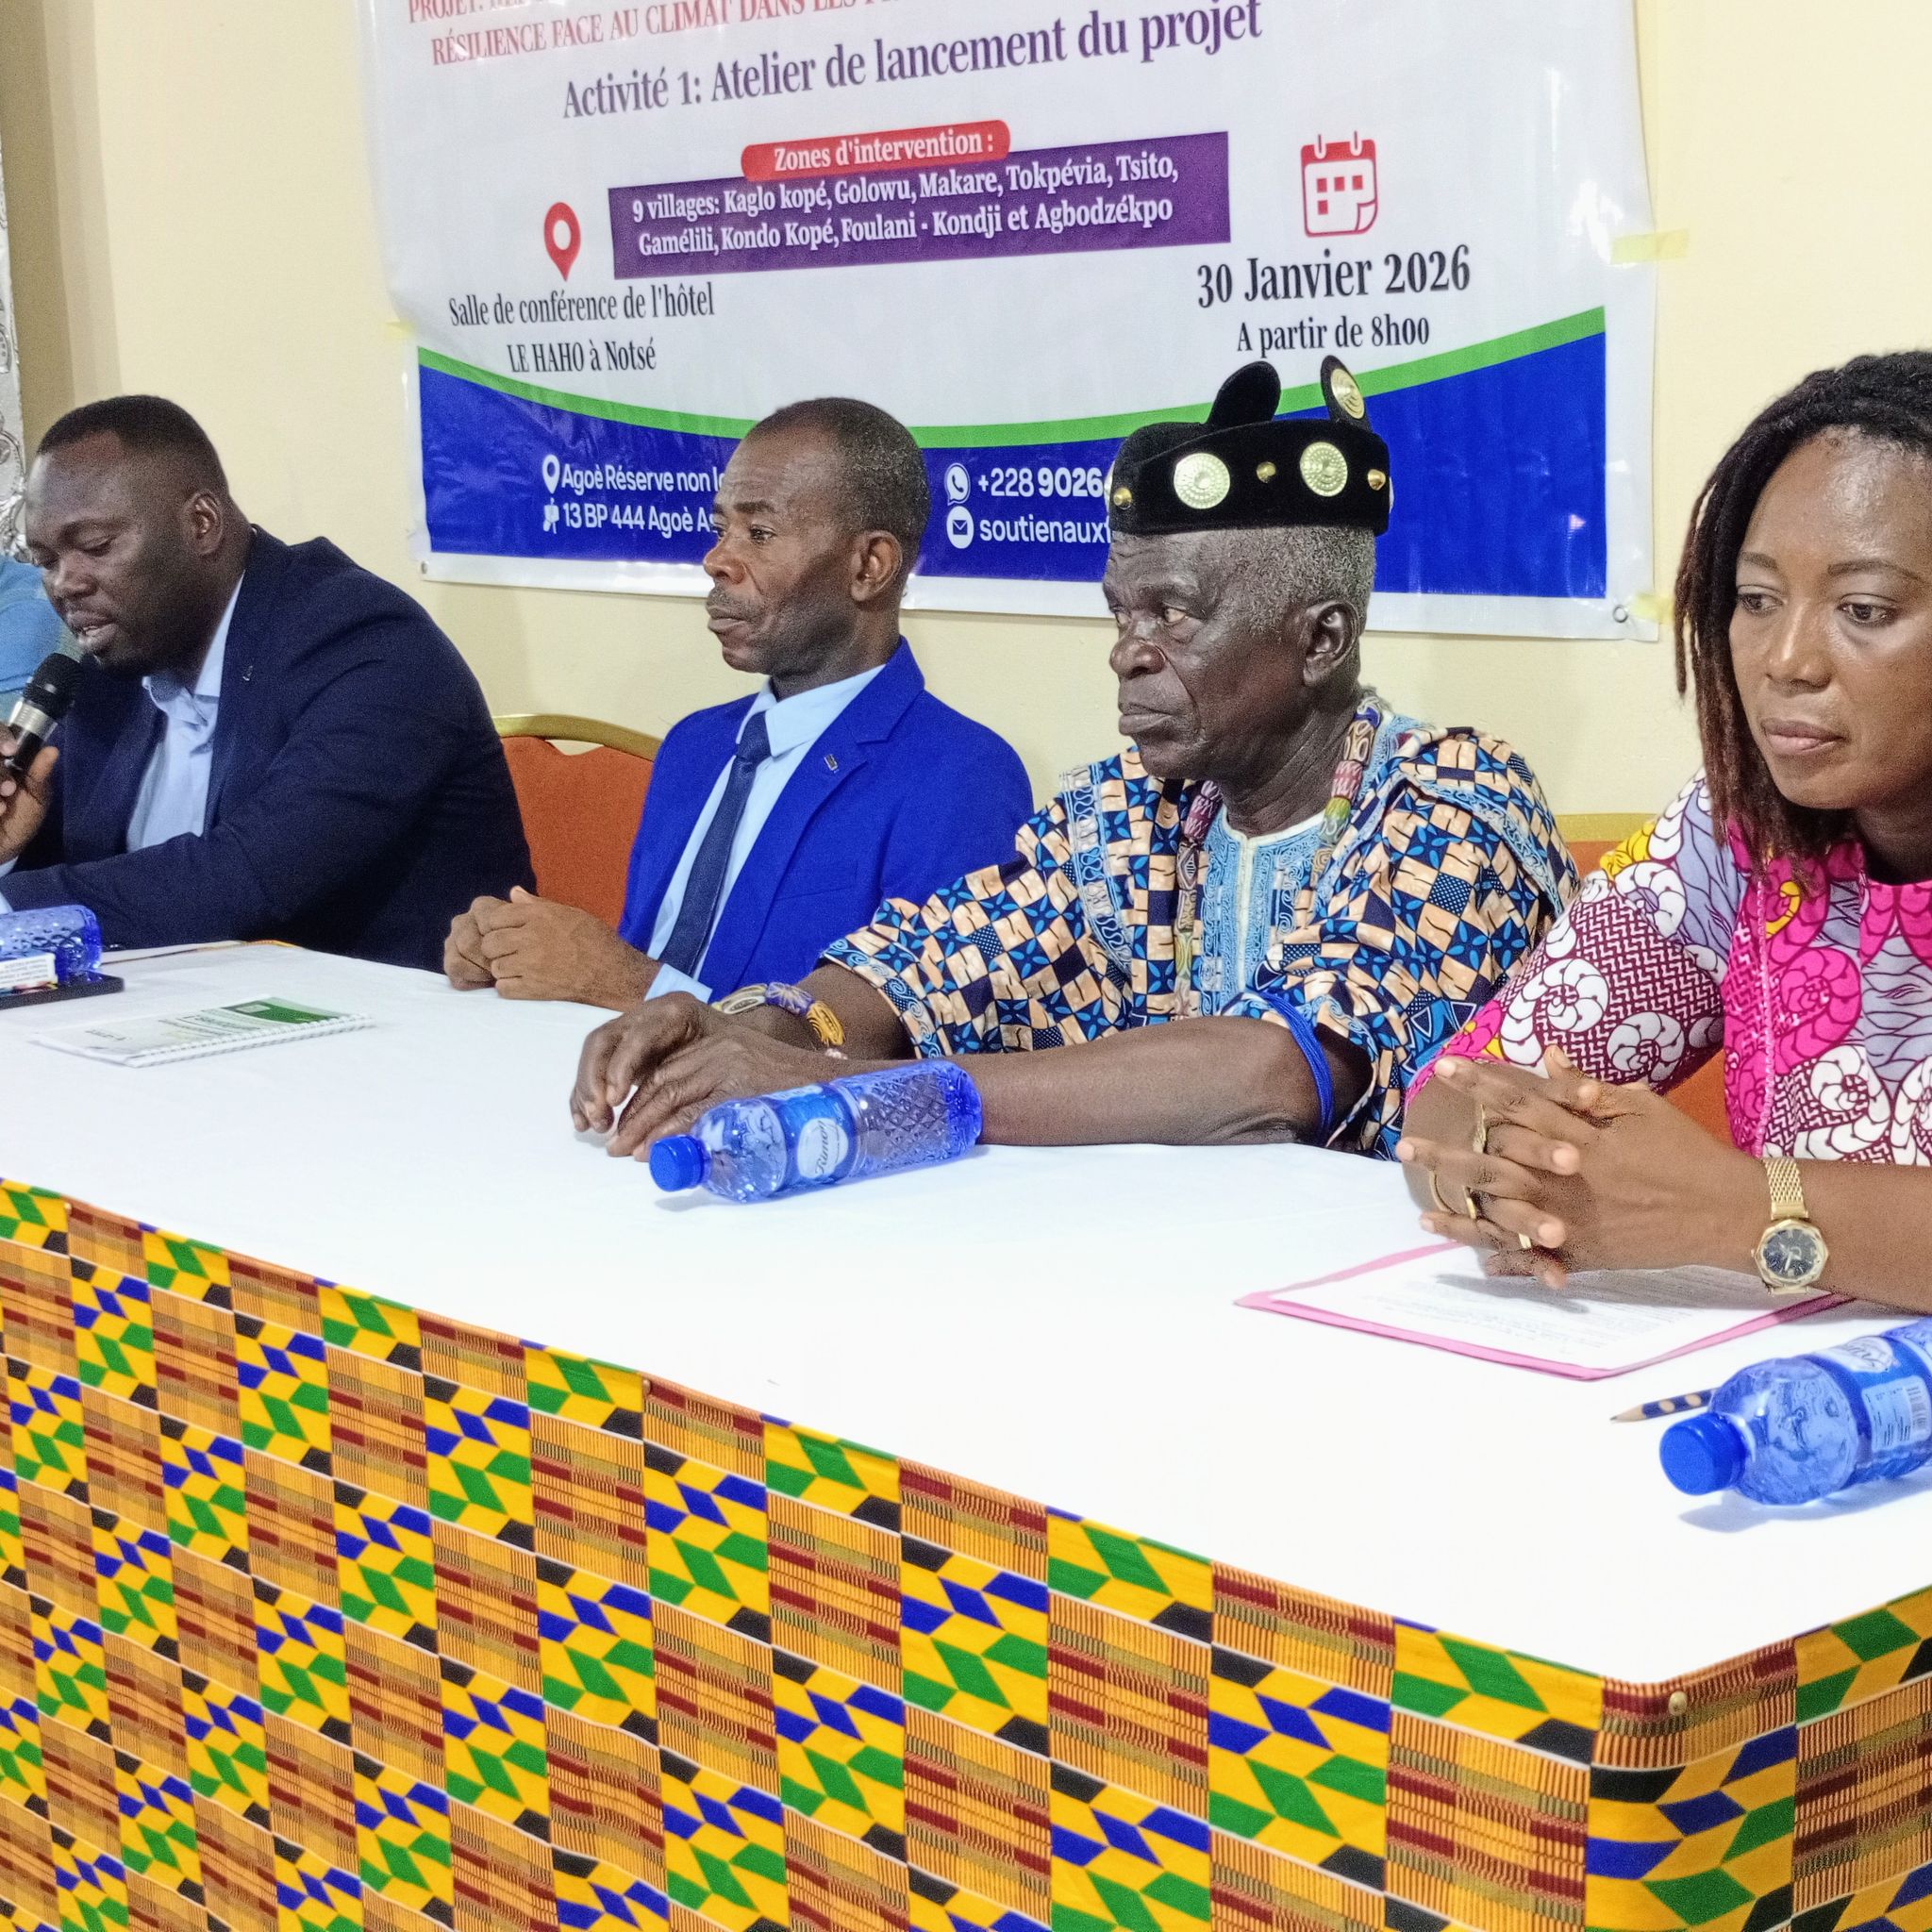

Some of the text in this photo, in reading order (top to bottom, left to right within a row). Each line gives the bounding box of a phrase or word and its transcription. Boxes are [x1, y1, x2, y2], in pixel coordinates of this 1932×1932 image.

[431, 0, 806, 66] RÉSILIENCE FACE AU CLIMAT DANS
[562, 0, 1263, 119] Activité 1: Atelier de lancement du projet
[774, 146, 831, 172] Zones
[835, 129, 983, 166] d'intervention
[632, 151, 1178, 223] 9 villages: Kaglo kopé, Golowu, Makare, Tokpévia, Tsito,
[639, 225, 720, 256] Gamélili,
[721, 223, 781, 251] Kondo
[784, 217, 840, 251] Kopé,
[841, 210, 918, 242] Foulani
[932, 205, 1003, 239] Kondji
[1008, 205, 1030, 231] et
[1035, 194, 1174, 234] Agbodzékpo
[1197, 244, 1471, 308] 30 Janvier 2026
[449, 281, 715, 326] Salle de conférence de l'hôtel
[507, 337, 658, 373] LE HAHO à Notsé
[1237, 313, 1430, 358] A partir de 8h00
[561, 463, 604, 496] Agoè
[605, 463, 675, 491] Réserve
[677, 471, 710, 492] non
[978, 467, 1104, 498] +228 9026
[563, 502, 582, 529] 13
[584, 503, 608, 529] BP
[611, 505, 646, 530] 444
[648, 506, 694, 539] Agoè
